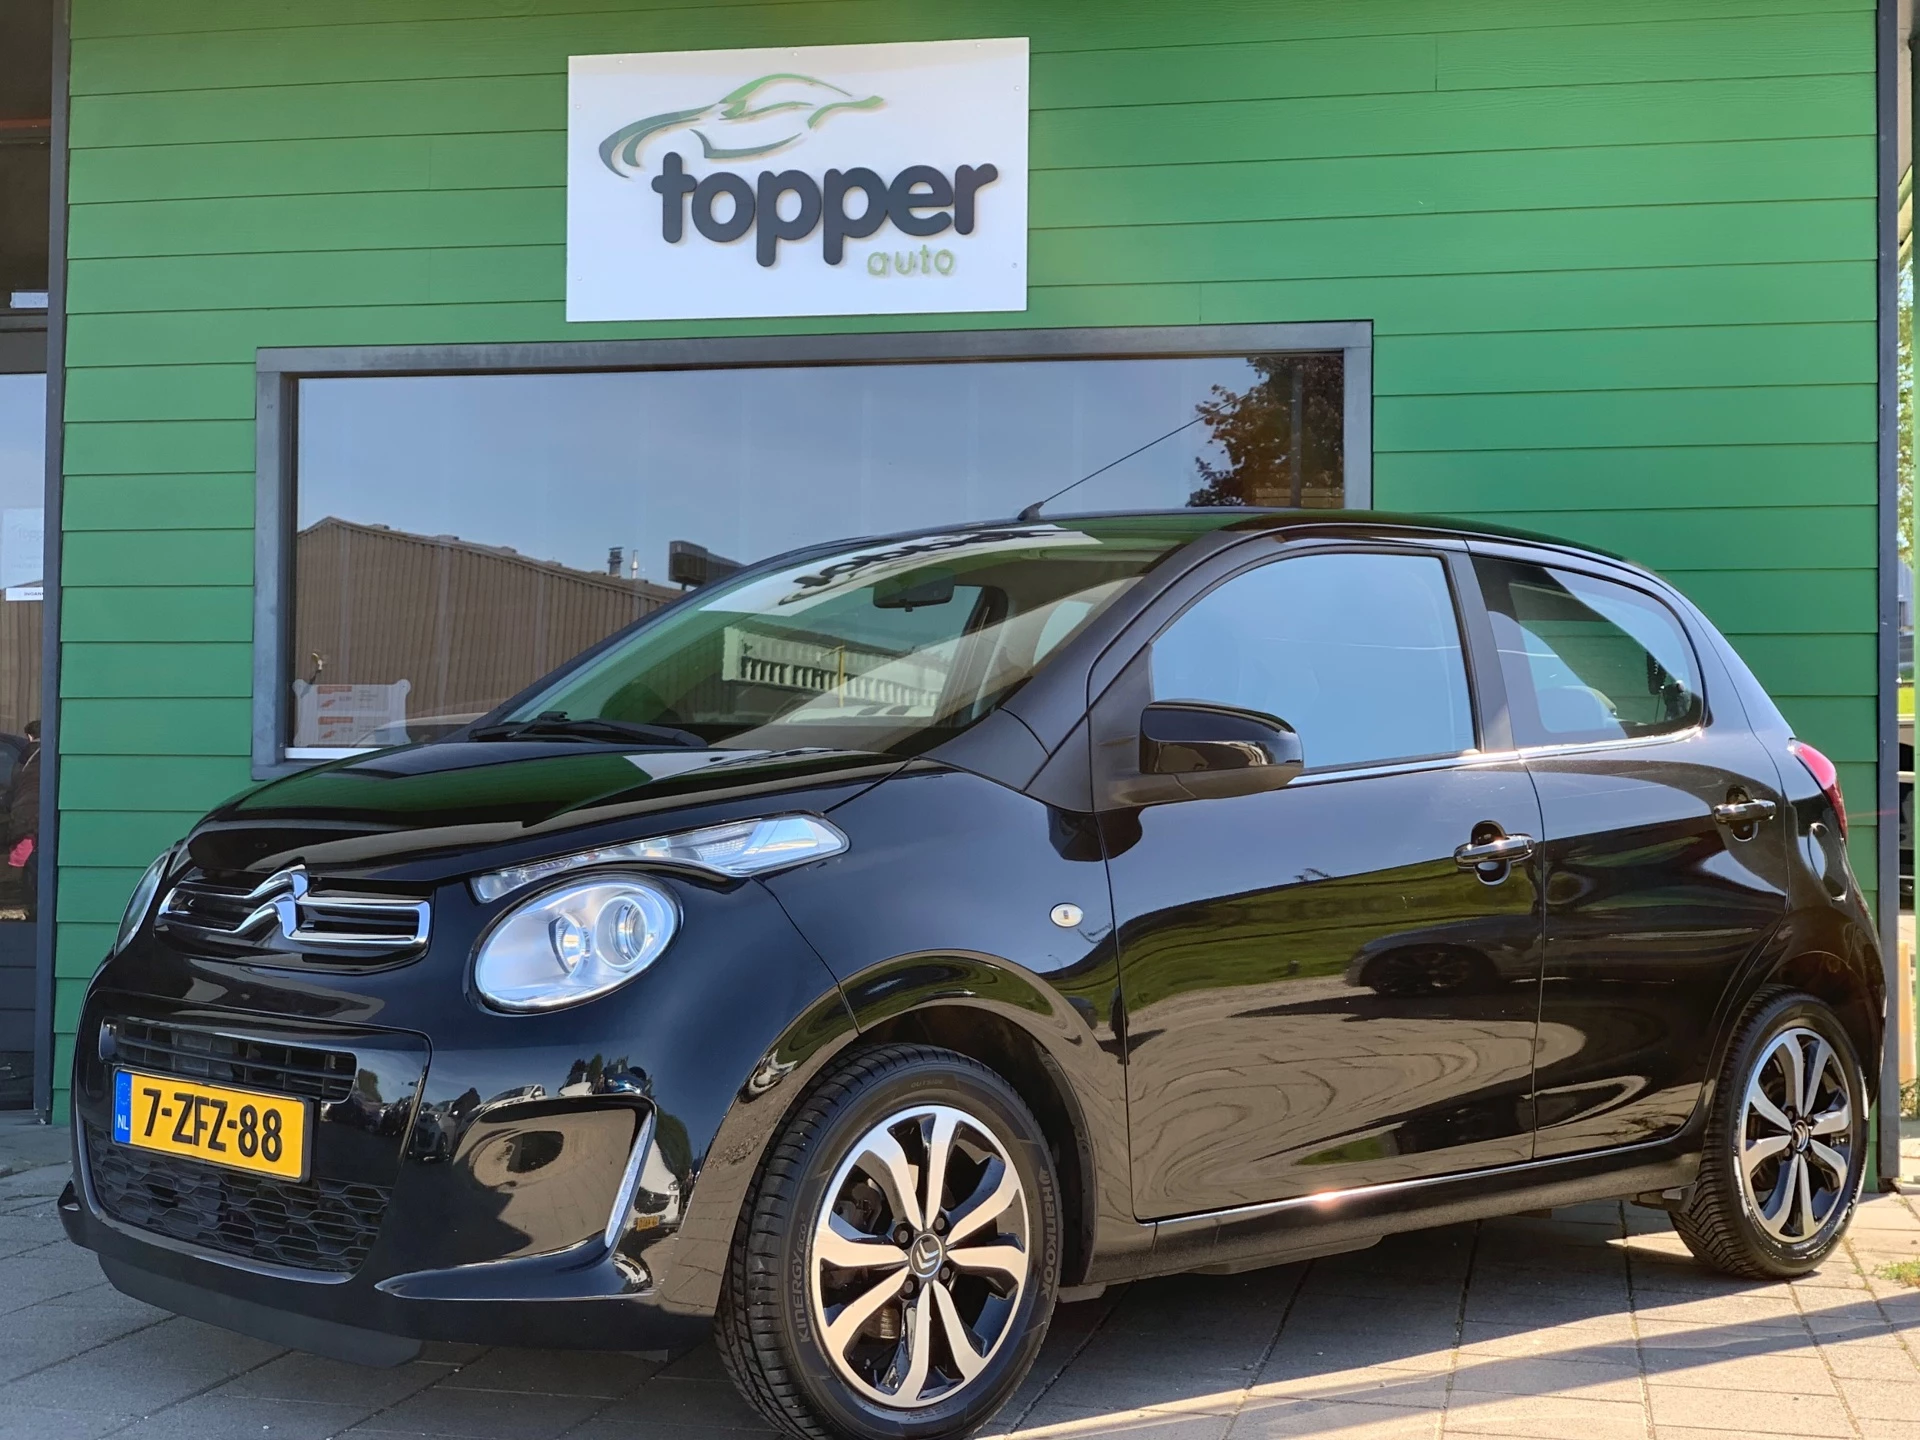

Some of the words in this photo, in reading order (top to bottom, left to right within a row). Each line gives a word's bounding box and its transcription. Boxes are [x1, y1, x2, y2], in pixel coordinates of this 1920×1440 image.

[651, 151, 998, 267] topper
[867, 245, 955, 275] auto
[117, 1113, 129, 1131] NL
[143, 1088, 282, 1162] 7-ZFZ-88
[791, 1252, 810, 1342] KINERGY
